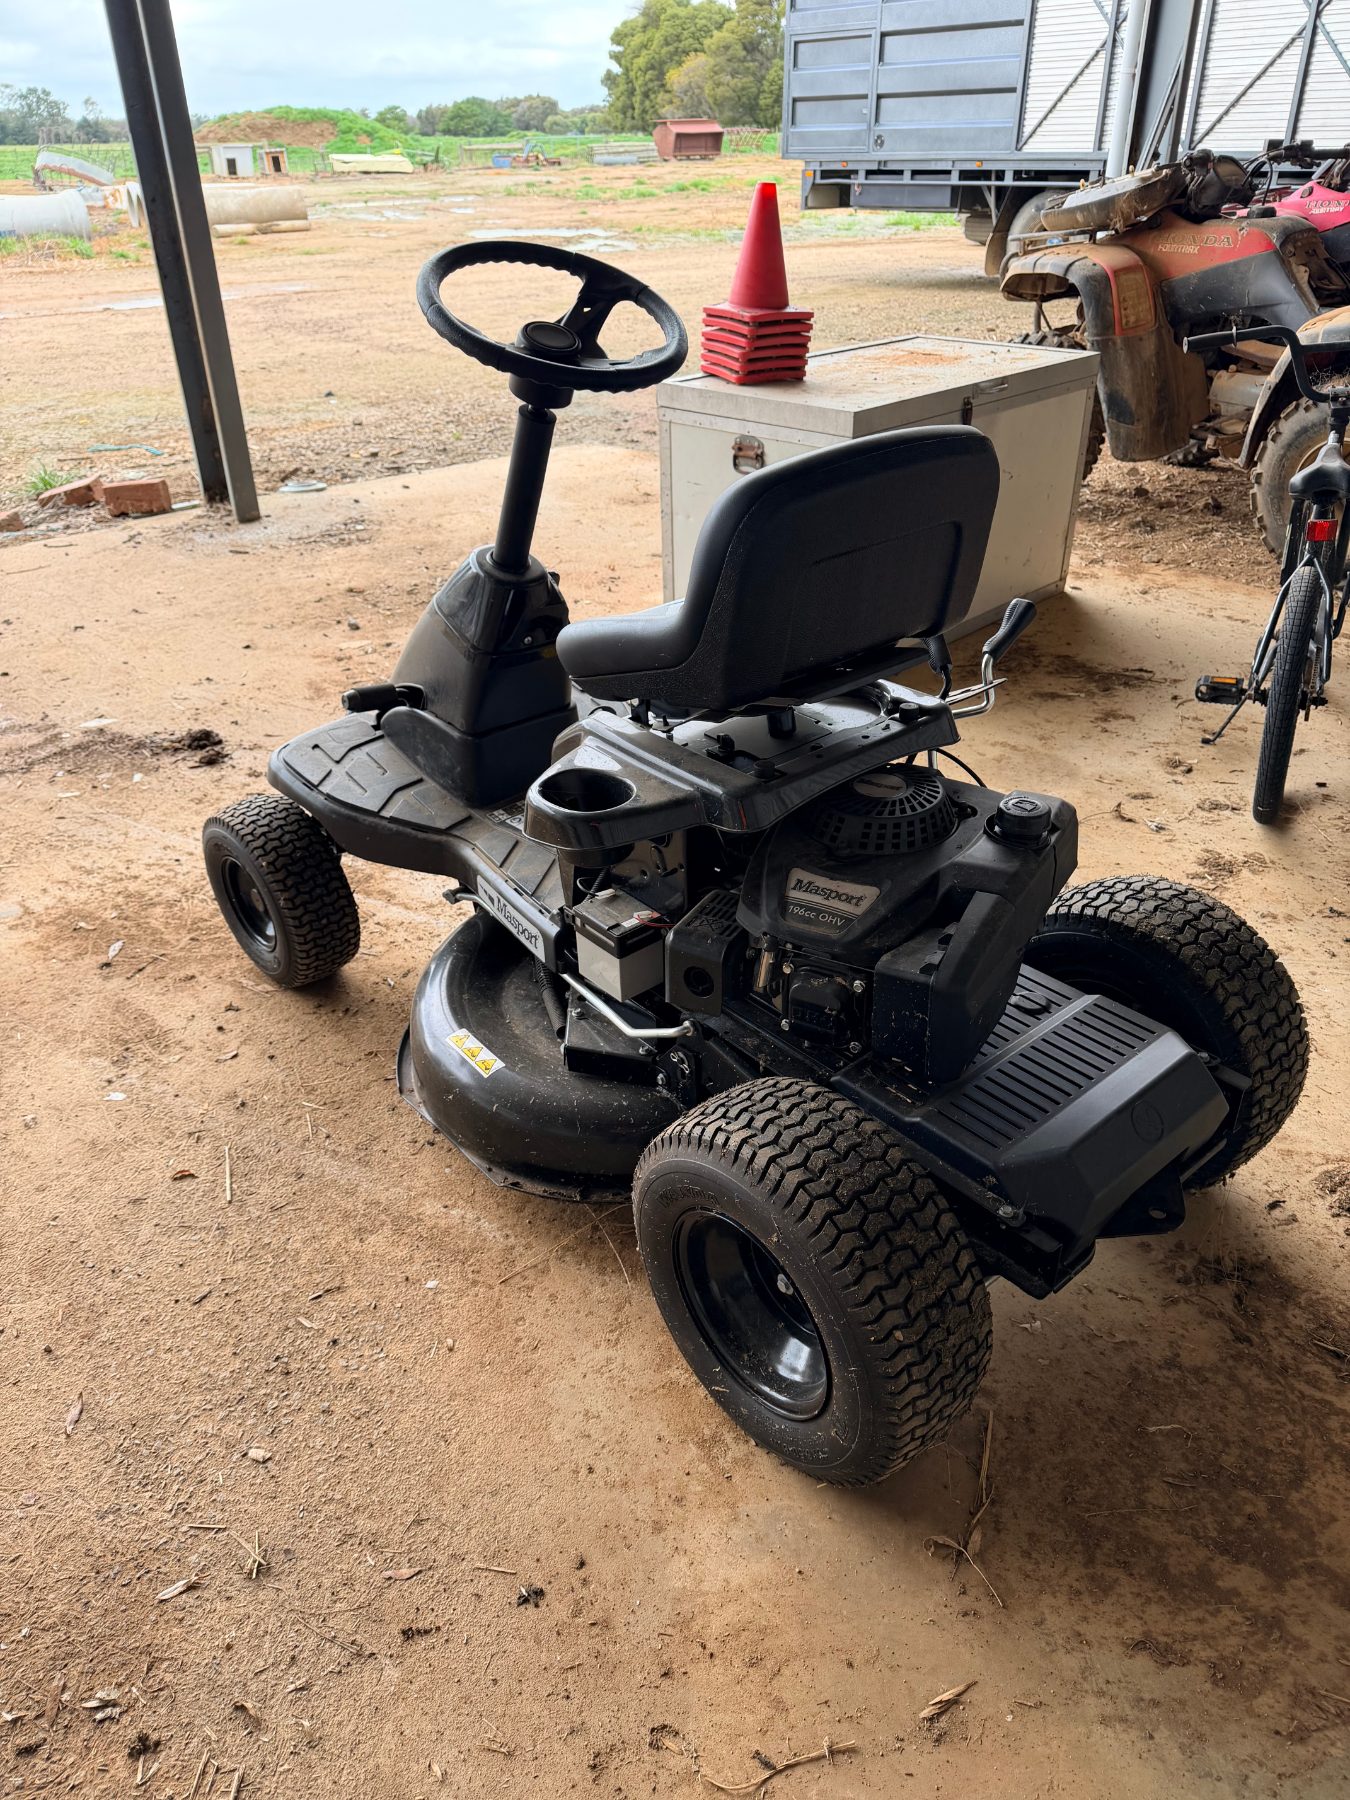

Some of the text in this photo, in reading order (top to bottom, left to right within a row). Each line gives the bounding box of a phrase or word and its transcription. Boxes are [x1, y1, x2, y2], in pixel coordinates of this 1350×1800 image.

[791, 878, 864, 907] Masport
[496, 895, 539, 950] Masport
[788, 905, 846, 926] 196cc OHV
